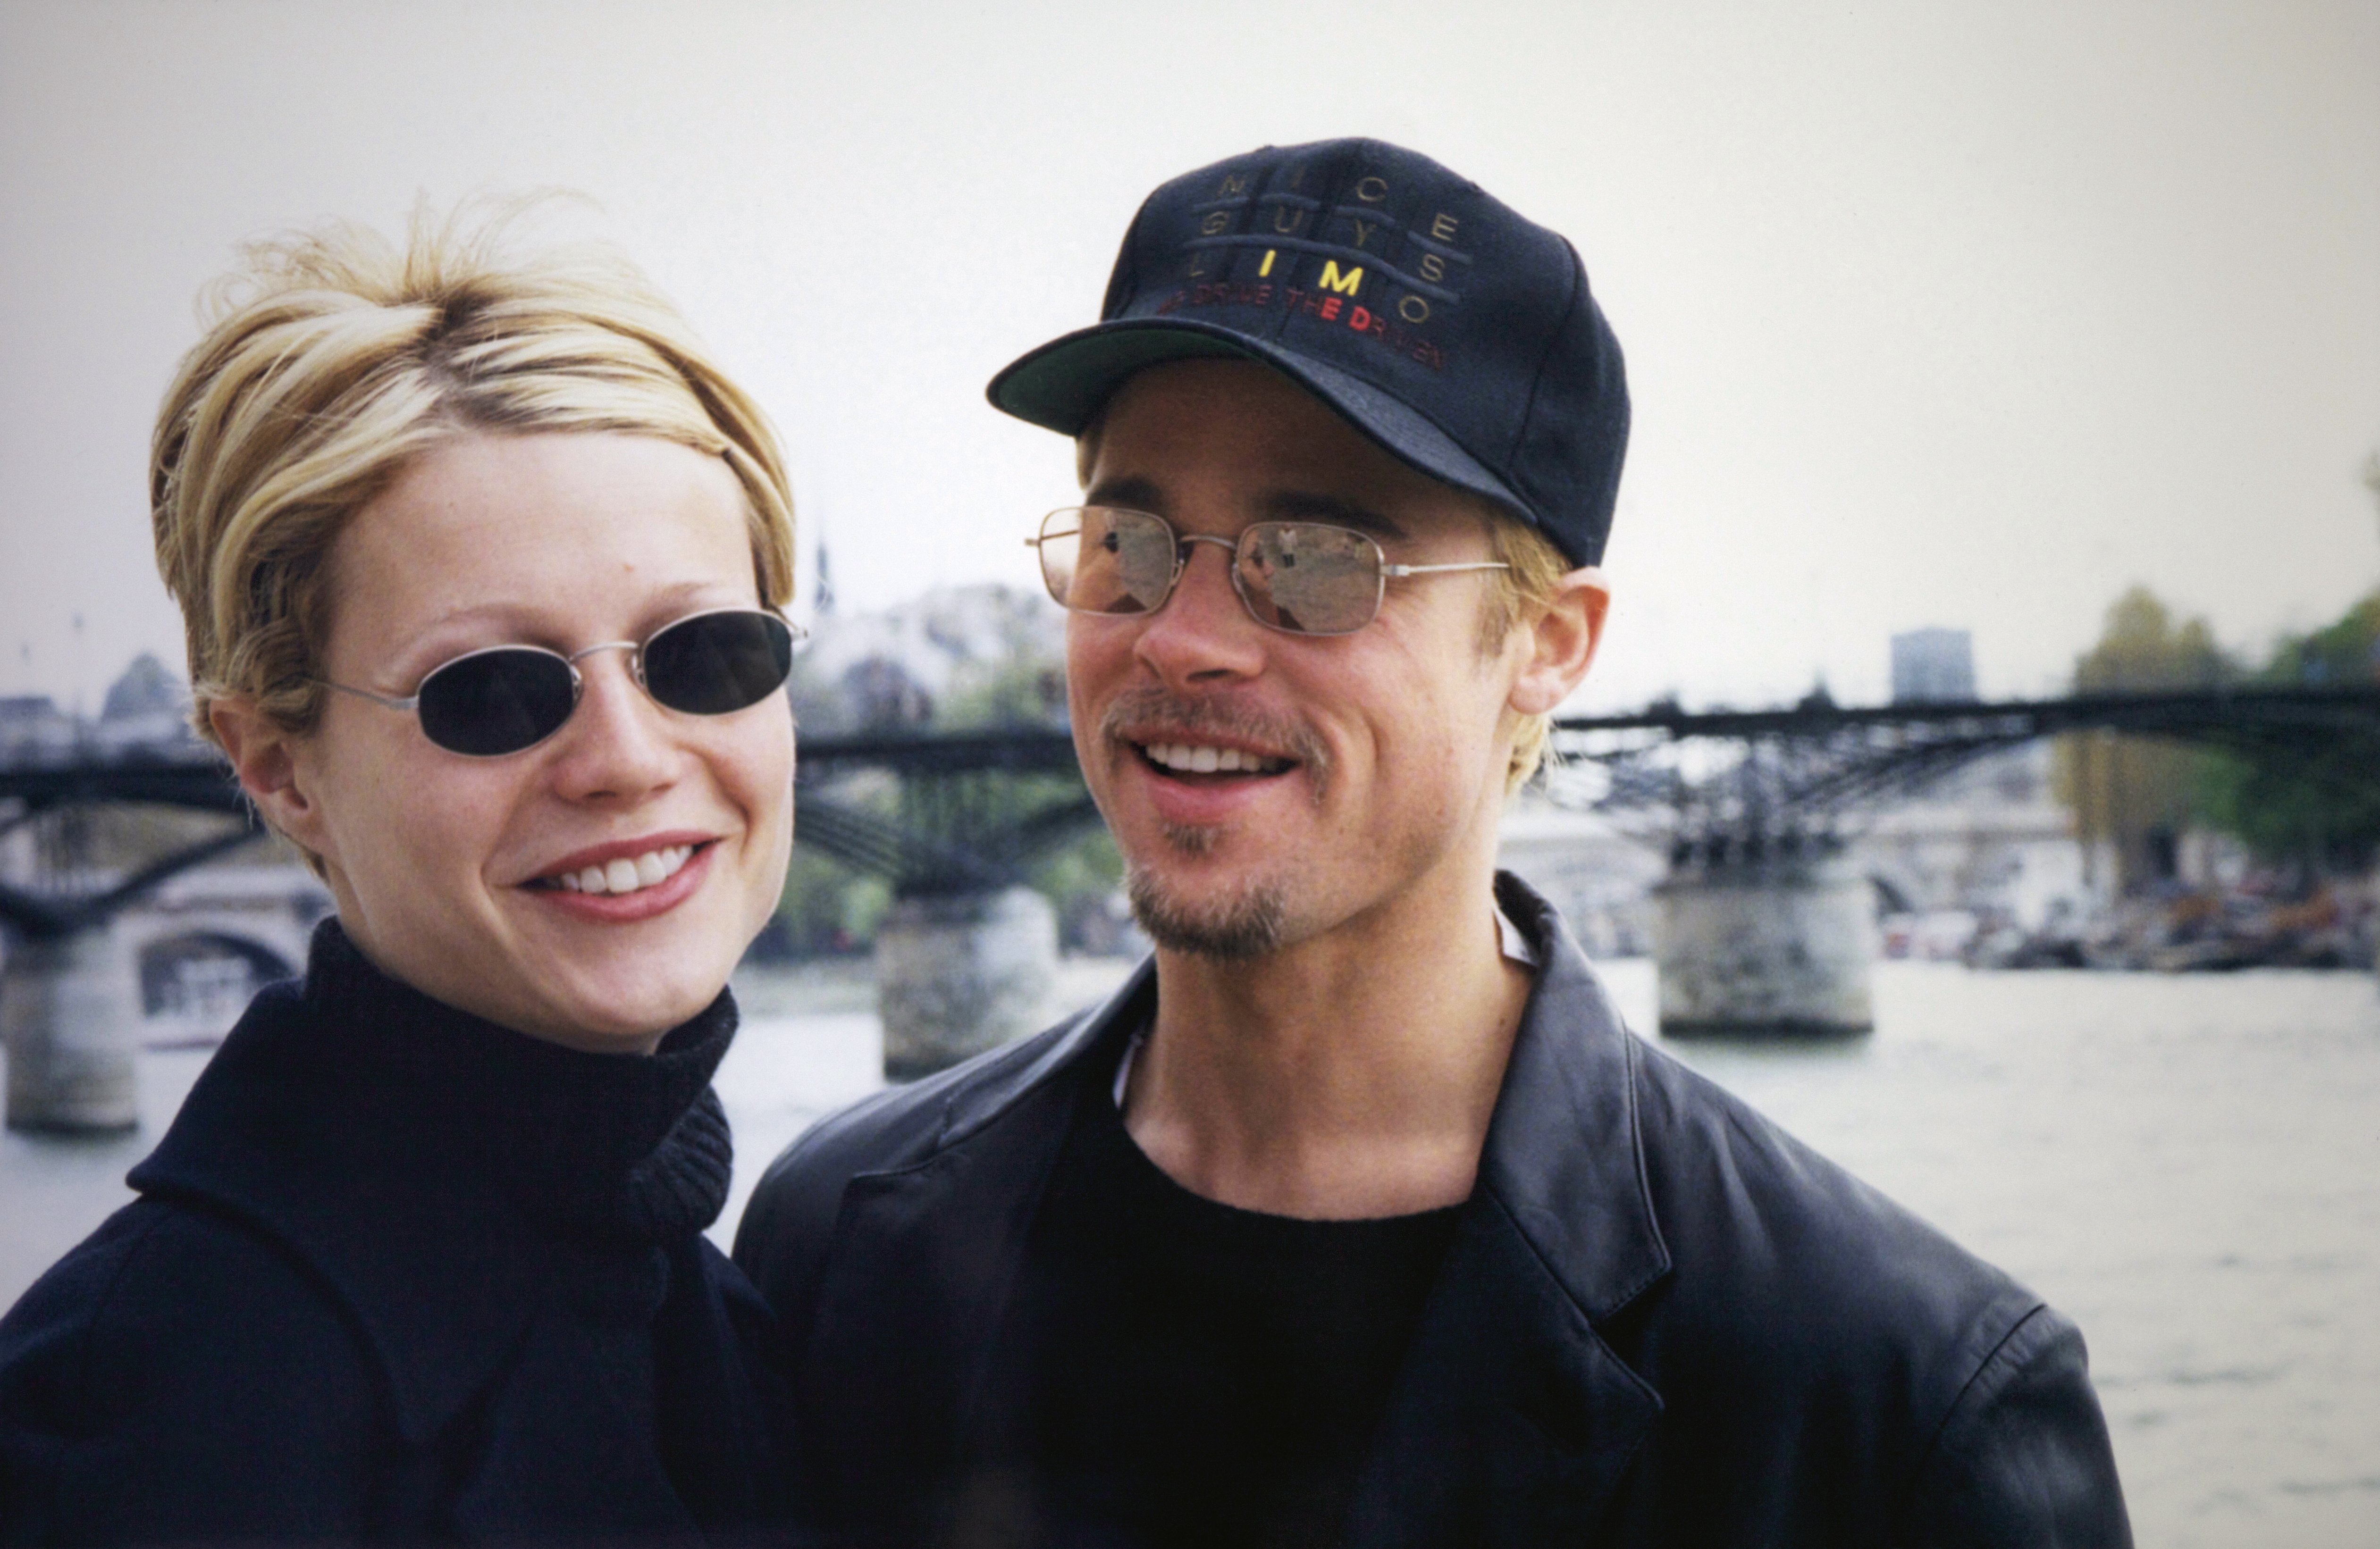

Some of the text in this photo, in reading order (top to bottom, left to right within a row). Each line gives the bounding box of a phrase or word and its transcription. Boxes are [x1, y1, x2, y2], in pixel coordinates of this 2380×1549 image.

[1217, 166, 1459, 242] NICE
[1200, 206, 1445, 283] GUYS
[1188, 249, 1430, 324] LIMO
[1285, 287, 1343, 322] THE
